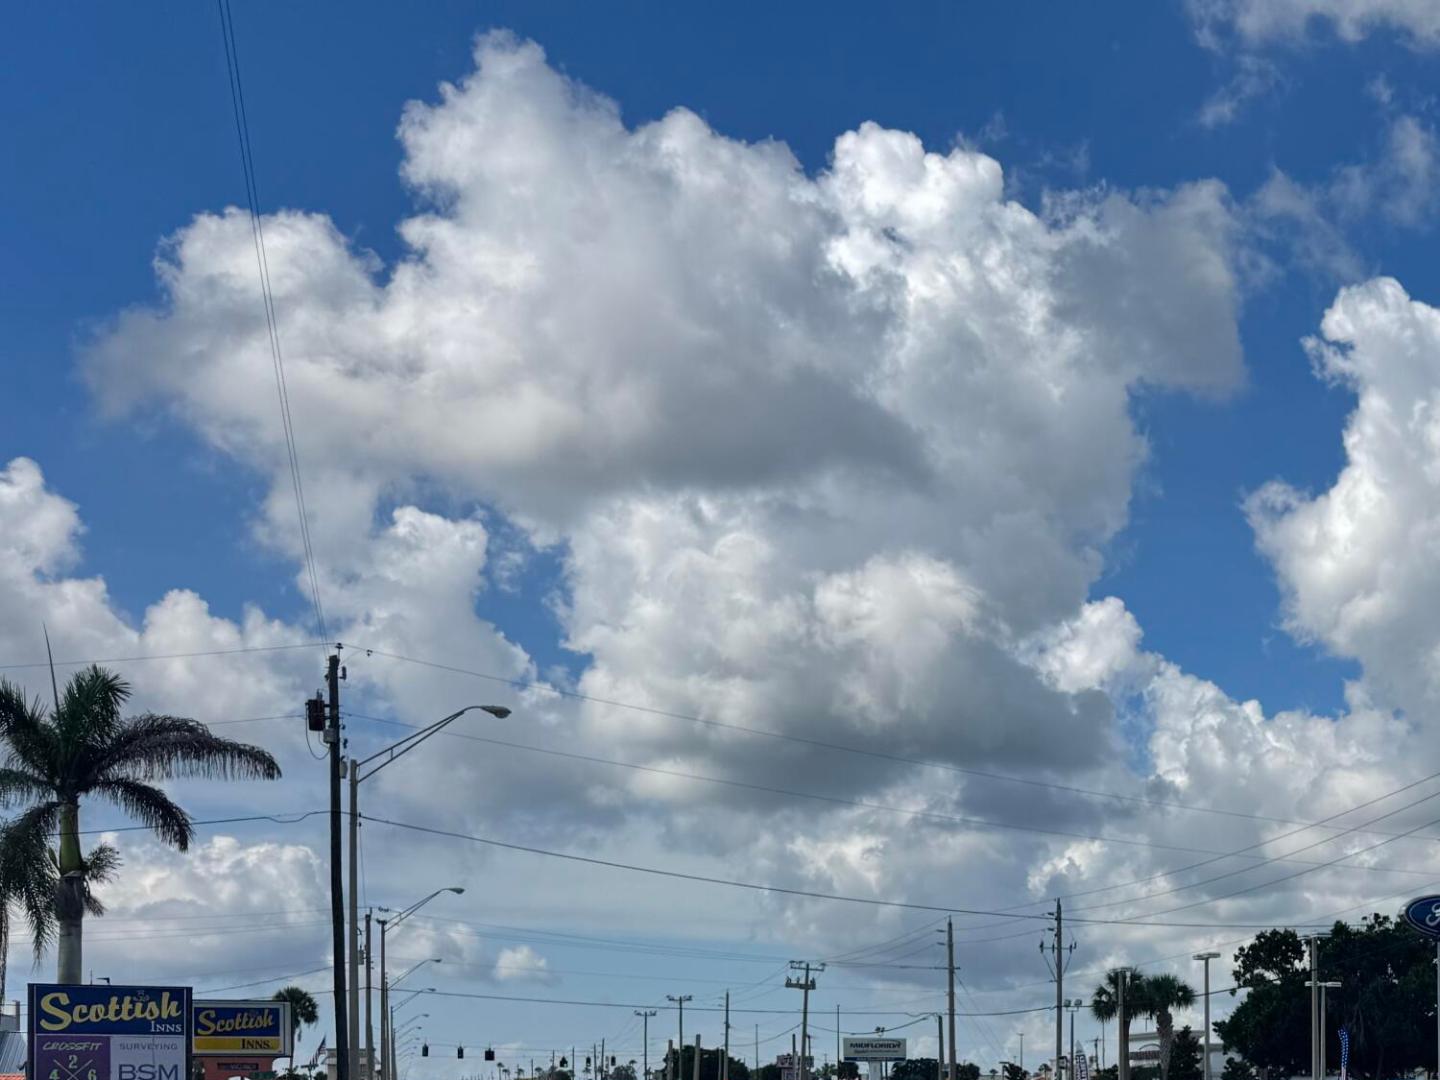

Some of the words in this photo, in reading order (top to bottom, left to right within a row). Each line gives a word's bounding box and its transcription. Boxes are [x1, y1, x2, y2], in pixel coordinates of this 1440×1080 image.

[40, 992, 182, 1031] Scottish
[197, 1008, 274, 1036] Scottish
[42, 1041, 103, 1051] CROSSFIT
[119, 1042, 178, 1050] SURVEYING
[68, 1054, 78, 1069] 2
